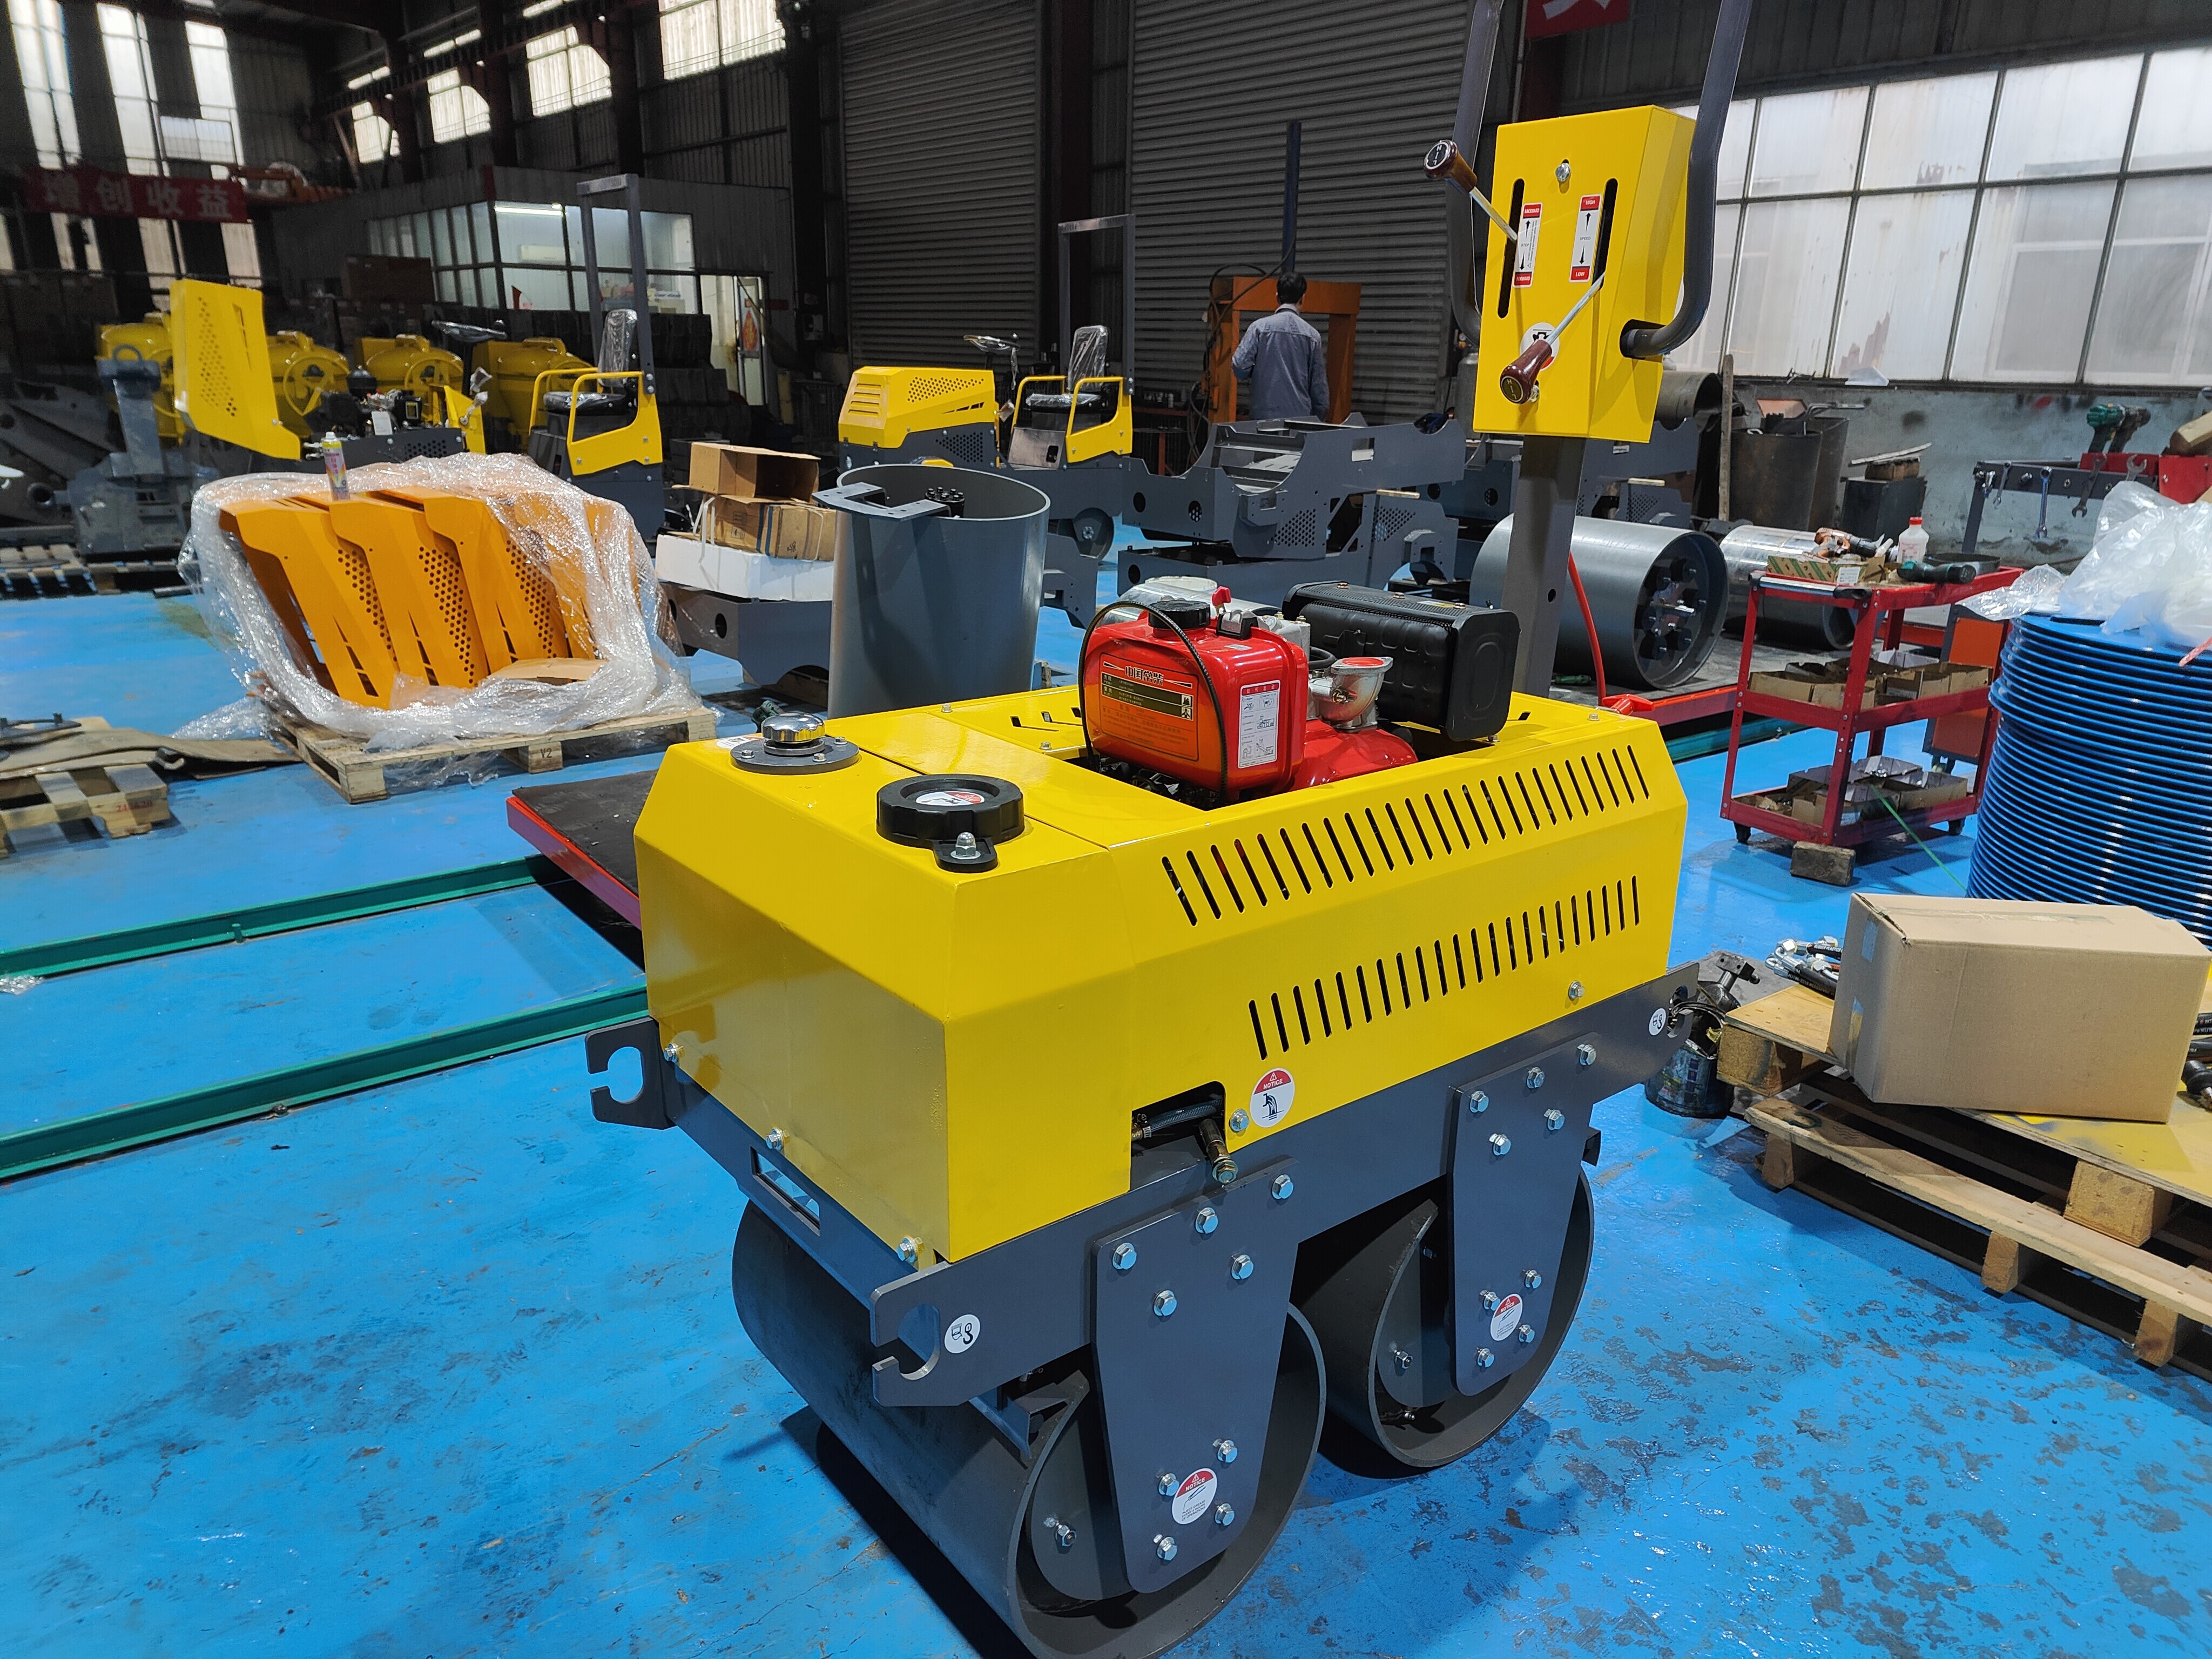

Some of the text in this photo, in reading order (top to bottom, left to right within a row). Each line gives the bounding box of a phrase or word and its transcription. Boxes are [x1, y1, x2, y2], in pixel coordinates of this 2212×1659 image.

[1125, 666, 1164, 686] 中国常柴
[1263, 1078, 1283, 1090] NOTICE
[1501, 1301, 1515, 1313] NOTICE
[1185, 1477, 1205, 1492] NOTICE
[1186, 1506, 1205, 1519] OPERATIONS
